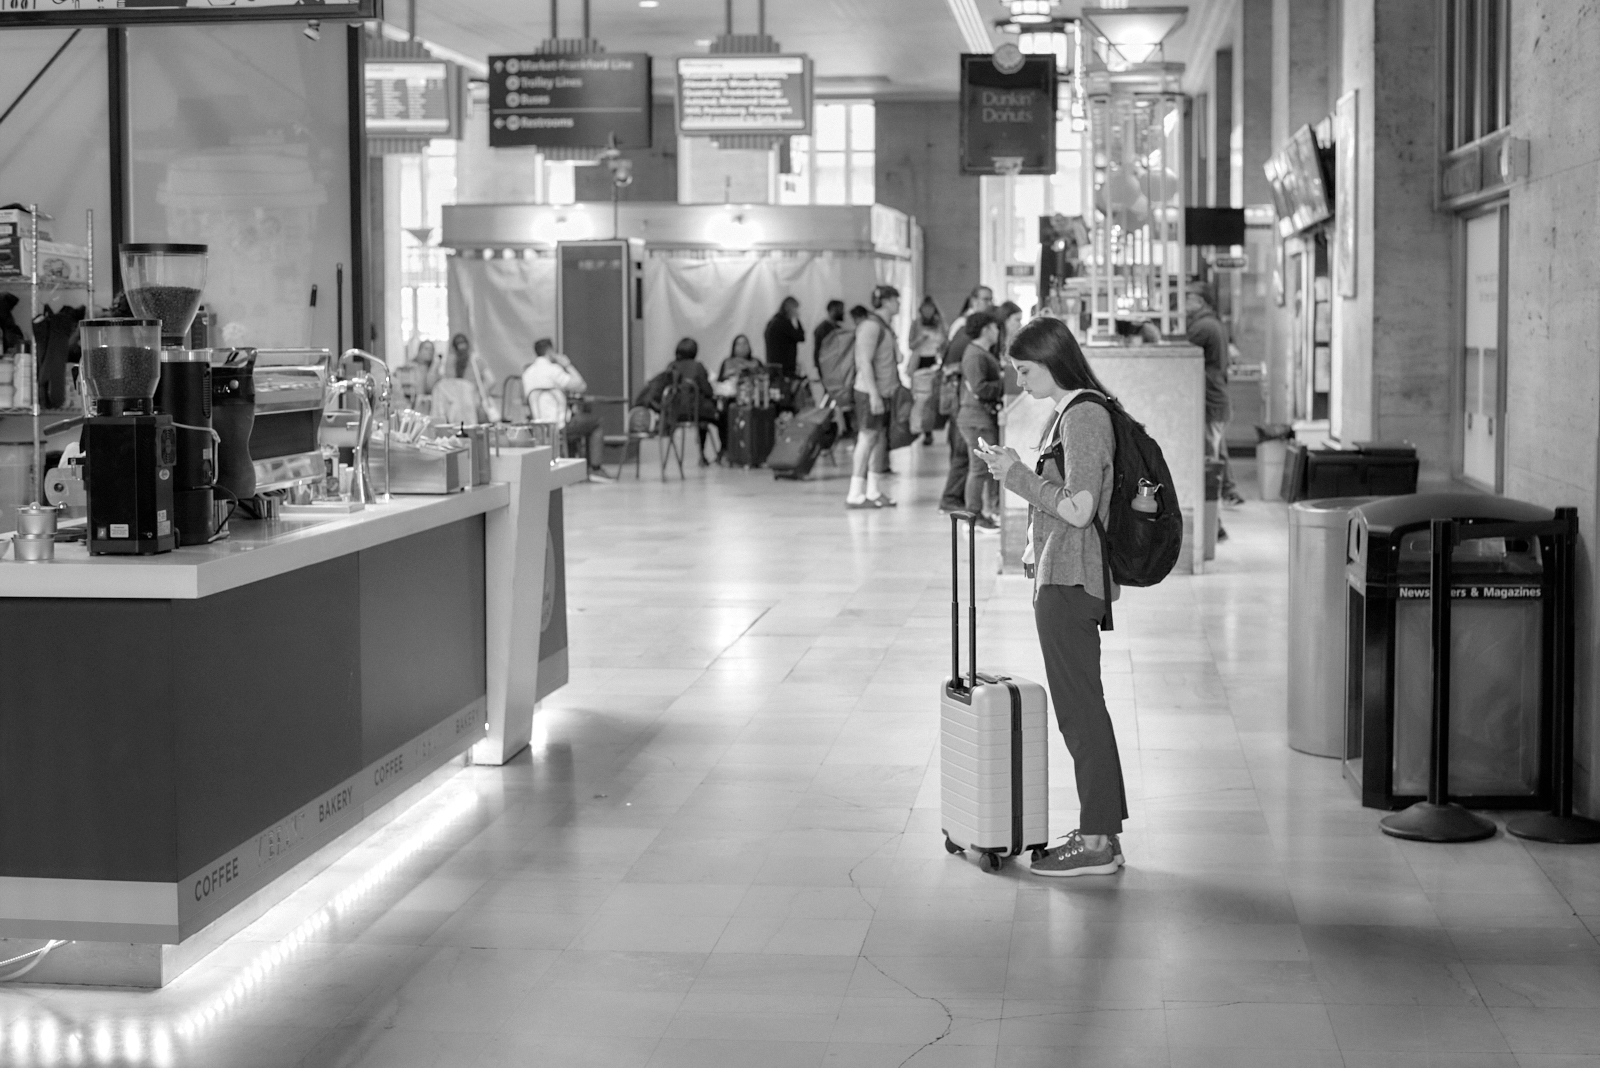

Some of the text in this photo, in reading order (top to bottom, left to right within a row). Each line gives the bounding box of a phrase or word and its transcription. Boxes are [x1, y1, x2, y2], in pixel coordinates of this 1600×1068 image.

[610, 59, 634, 71] Line
[520, 76, 583, 90] Trolley Lines
[520, 93, 550, 105] Buses
[982, 107, 1034, 123] Donuts
[520, 116, 574, 129] Restrooms
[1399, 586, 1542, 600] Newsers & Magazines
[194, 857, 239, 902] COFFEE
[318, 786, 354, 823] BAKERY
[374, 754, 404, 786] COFFEE
[455, 709, 480, 734] BAKERY
